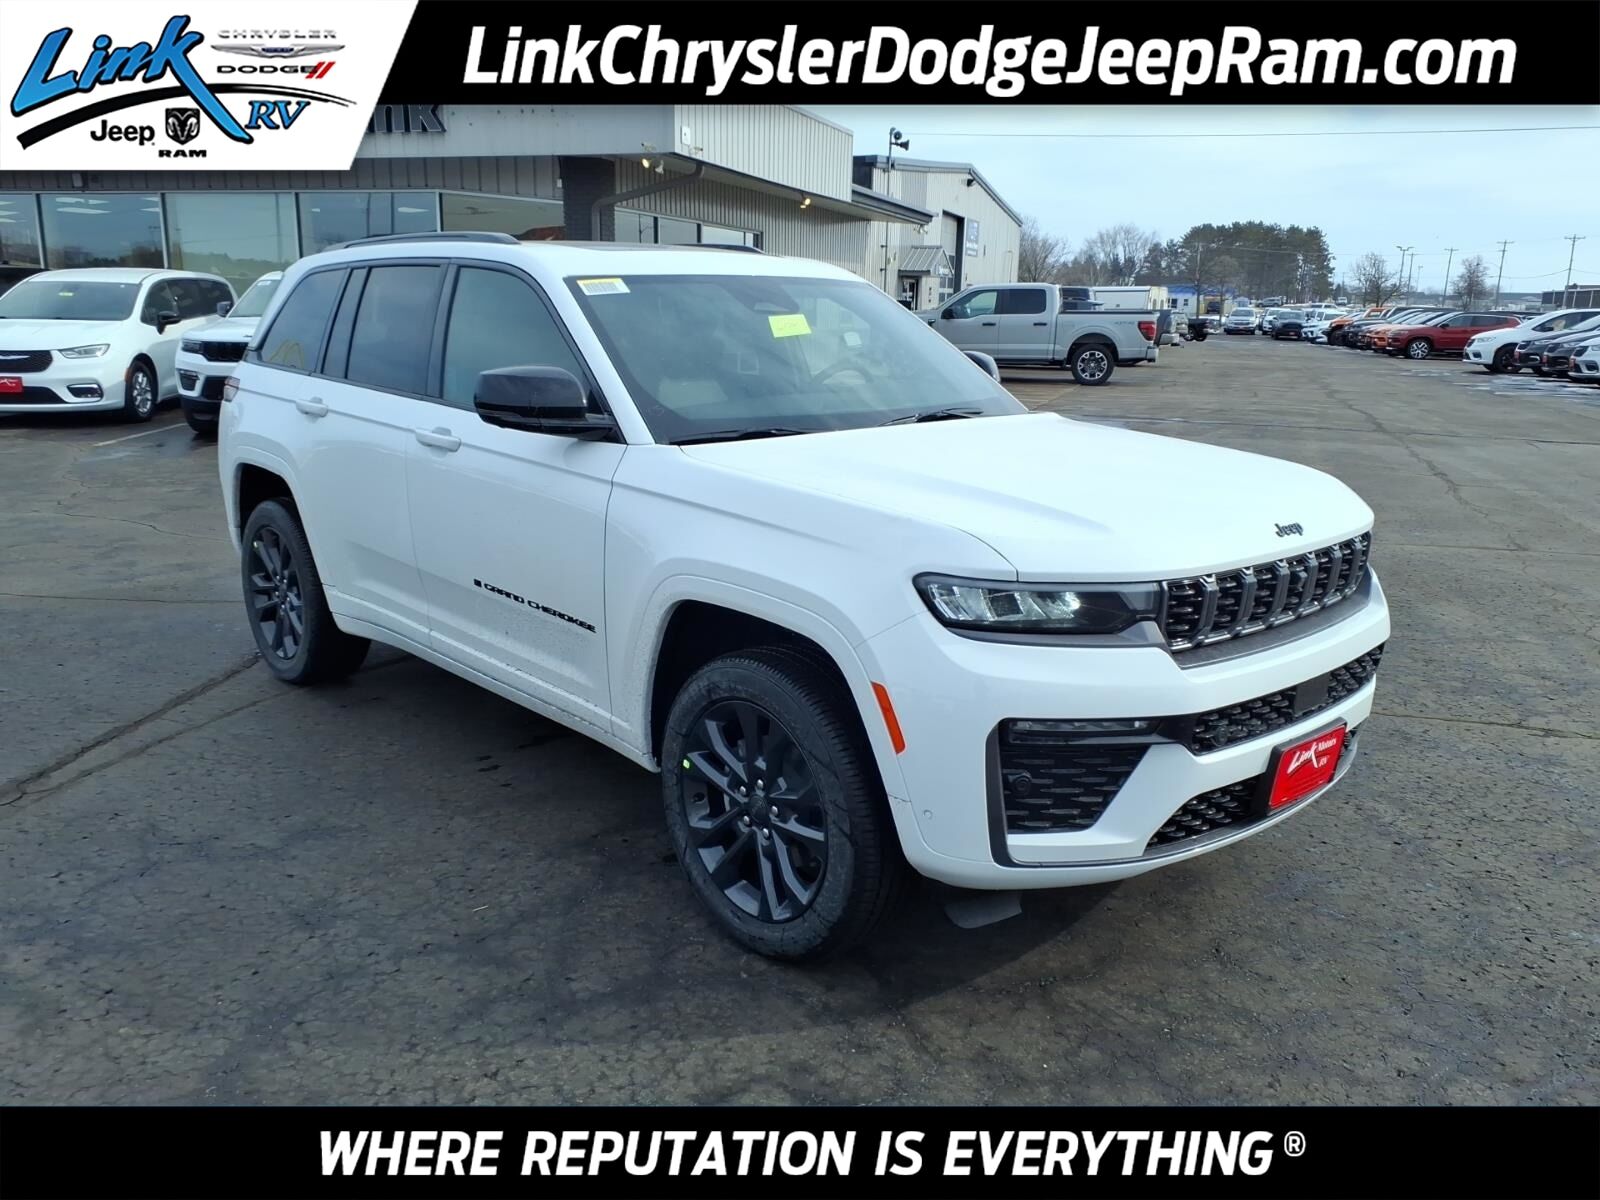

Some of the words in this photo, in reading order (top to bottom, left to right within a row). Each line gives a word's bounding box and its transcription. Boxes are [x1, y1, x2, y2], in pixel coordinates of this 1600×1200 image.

[1274, 523, 1304, 538] Jeep
[484, 583, 525, 604] GRAND
[527, 600, 597, 633] CHEROKEE
[1287, 742, 1318, 774] Link
